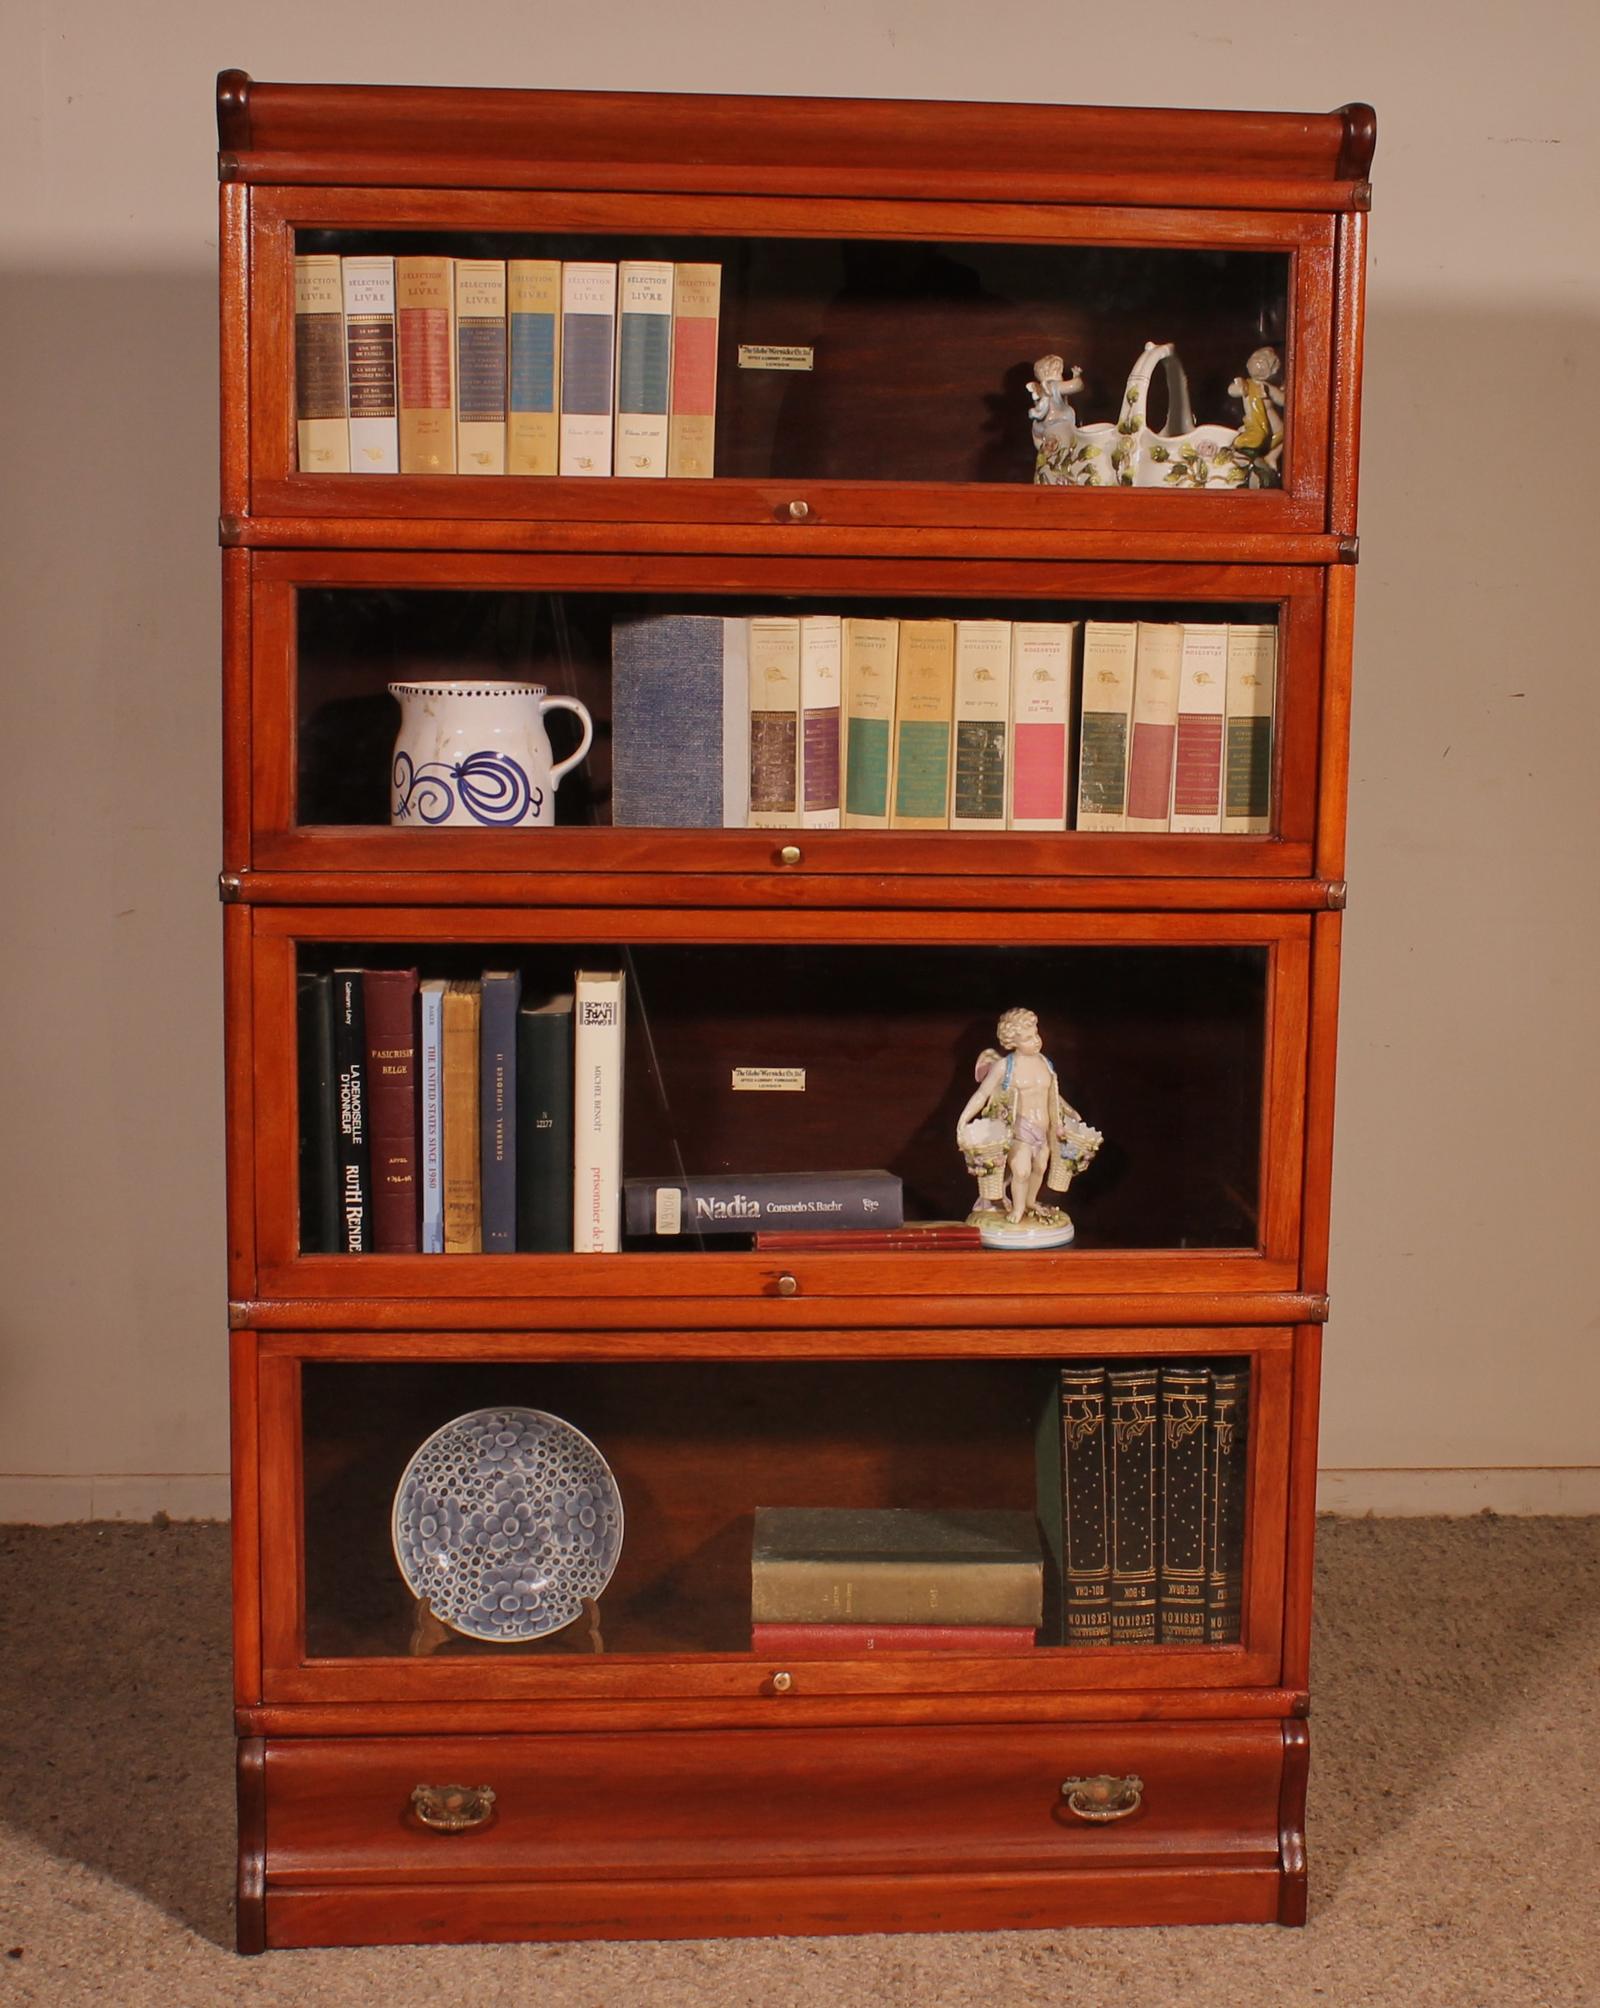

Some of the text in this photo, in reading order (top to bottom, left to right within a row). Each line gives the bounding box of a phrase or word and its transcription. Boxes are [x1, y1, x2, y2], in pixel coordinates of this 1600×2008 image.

[408, 288, 440, 296] LIVRE
[574, 293, 604, 301] LIVRE
[631, 292, 663, 301] LIVRE
[682, 295, 712, 303] LIVRE
[466, 296, 498, 304] LIVRE
[585, 1008, 612, 1019] LIVRE
[382, 1065, 407, 1074] BELGE
[341, 1074, 351, 1134] D'HONNEUR
[350, 1064, 362, 1144] LA DEMOISELLE
[428, 1046, 437, 1189] THE UNITED STATES SINCE 1980
[345, 1165, 362, 1203] RUTH
[591, 1167, 604, 1224] prisonnier
[696, 1194, 760, 1220] Nadia
[766, 1201, 807, 1213] Consuelo
[816, 1201, 843, 1212] Baehr
[593, 1226, 604, 1240] de
[1068, 1611, 1111, 1625] LEKSIKON
[1112, 1612, 1155, 1627] LEKSIKON
[1162, 1611, 1204, 1625] LEKSIKON
